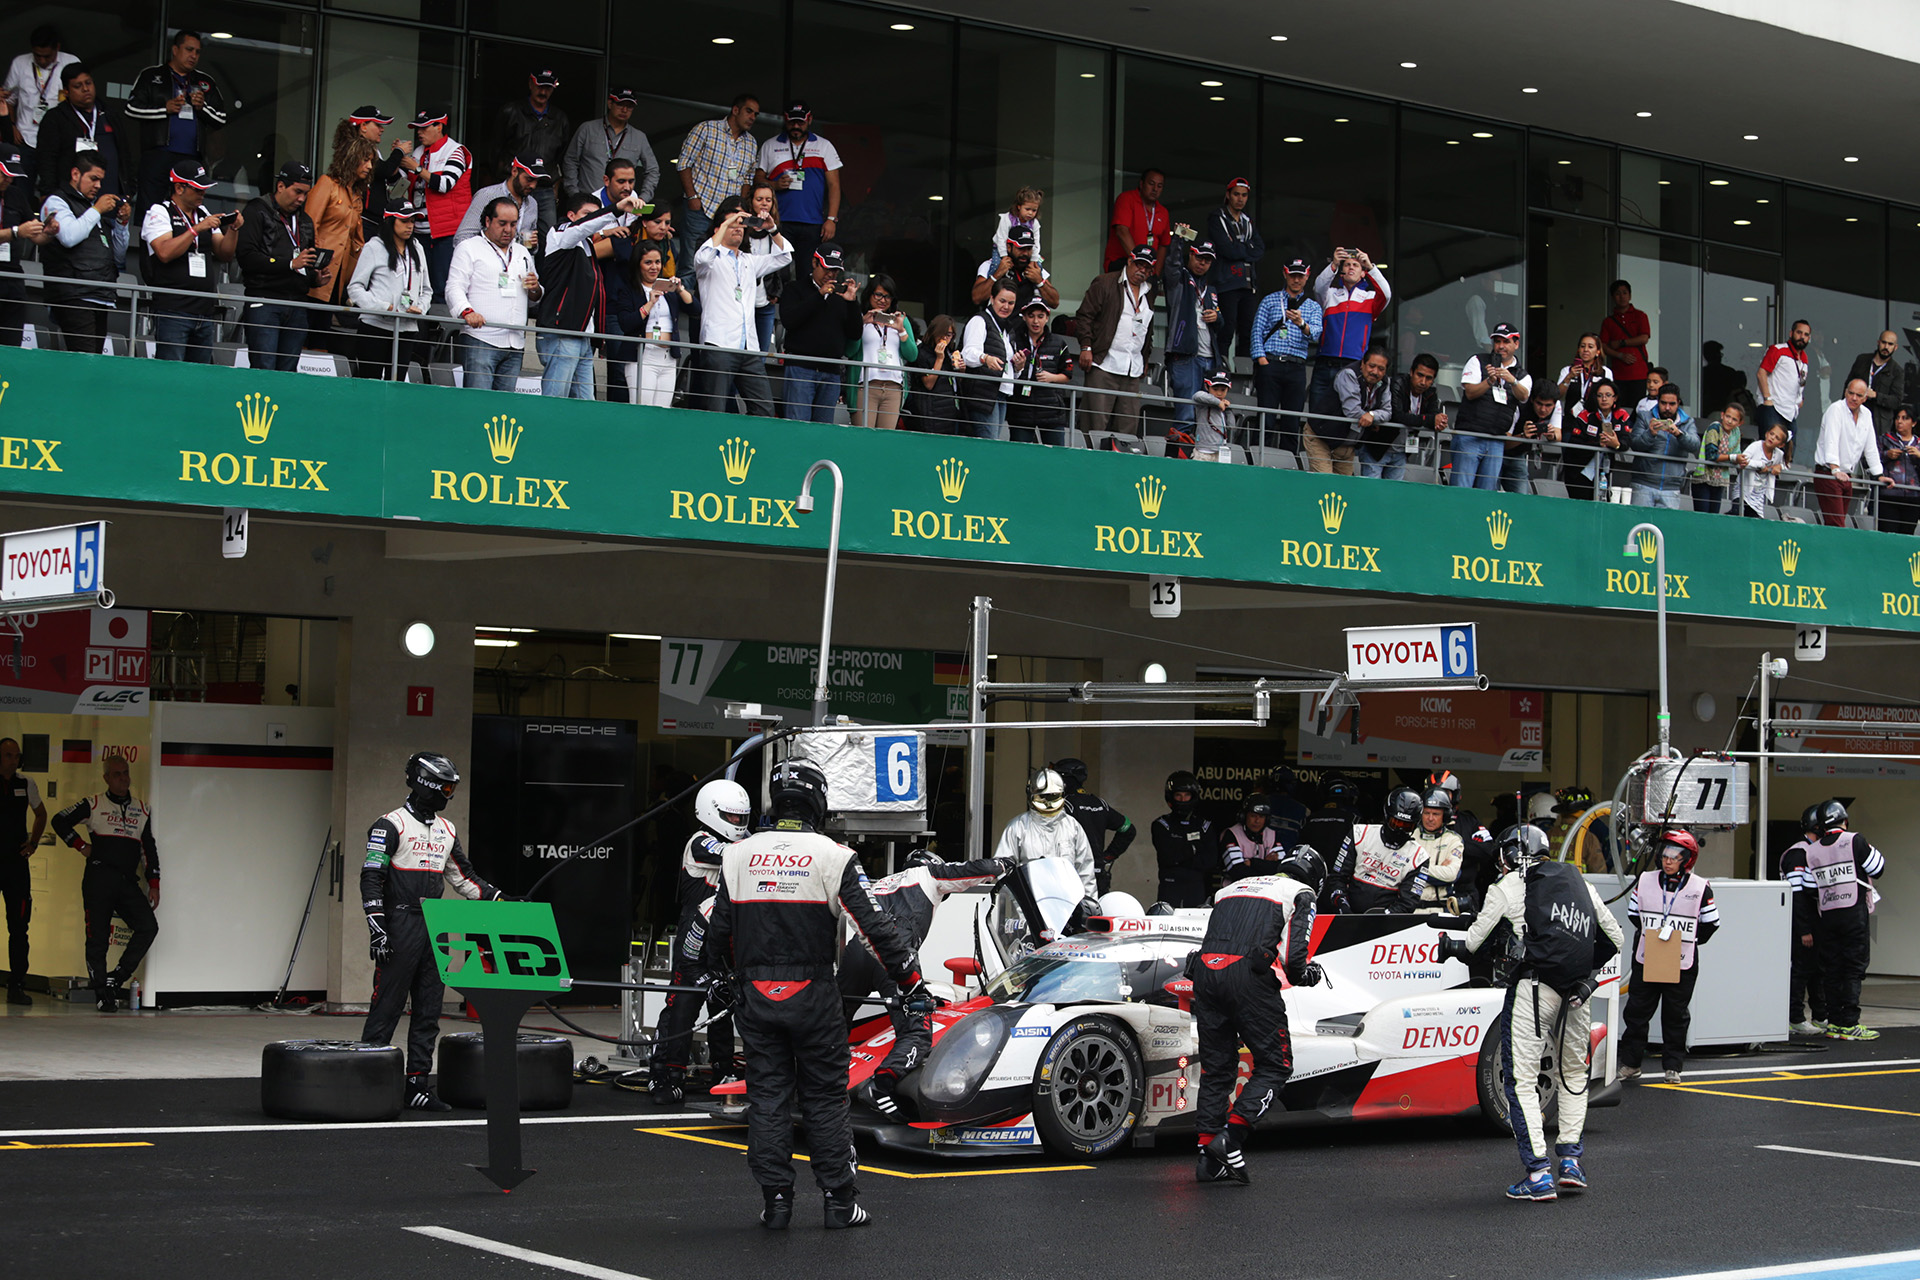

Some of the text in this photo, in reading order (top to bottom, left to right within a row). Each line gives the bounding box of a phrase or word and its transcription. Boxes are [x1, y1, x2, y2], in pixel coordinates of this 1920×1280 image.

[300, 365, 332, 373] RESERVADO
[179, 450, 329, 492] ROLEX
[431, 470, 570, 510] ROLEX
[670, 490, 799, 529] ROLEX
[225, 514, 245, 541] 14
[891, 509, 1010, 545] ROLEX
[1095, 525, 1204, 559] ROLEX
[8, 530, 95, 589] TOYOTA 5
[1281, 540, 1381, 573] ROLEX
[1451, 555, 1544, 588] ROLEX
[1152, 582, 1177, 606] 13
[1606, 568, 1690, 599] ROLEX
[1749, 581, 1828, 611] ROLEX
[1882, 592, 1920, 617] ROL
[1797, 630, 1822, 649] 12
[1352, 629, 1468, 675] TOYOTA 6
[89, 654, 110, 675] P1
[118, 655, 144, 677] HY
[669, 643, 703, 686] 77
[777, 688, 815, 700] PORSCH
[846, 692, 865, 702] RSR
[867, 693, 896, 704] (2016)
[1420, 697, 1452, 713] KCMG
[1395, 716, 1476, 730] PORSCHE 911 RSR
[1837, 705, 1857, 720] ABU
[526, 724, 616, 736] PORSCHE
[1521, 725, 1541, 742] GTE
[1845, 738, 1882, 751] PORSCHE
[1884, 741, 1897, 752] 911
[887, 742, 911, 796] 6
[1196, 766, 1223, 781] ABU
[417, 776, 443, 791] uvex
[1696, 778, 1728, 810] 77
[1397, 811, 1411, 820] uvex
[412, 841, 445, 853] DENSO
[749, 854, 812, 868] DENSO
[1363, 856, 1400, 878] DENSO
[1829, 865, 1853, 877] LANE
[1119, 918, 1153, 931] ZENT
[1370, 943, 1439, 964] DENSO
[1368, 970, 1442, 980] TOYOTA HYBRID
[1014, 1028, 1049, 1037] AISIN
[1050, 1026, 1077, 1060] MICHELIN
[1402, 1025, 1480, 1049] DENSO
[1289, 1072, 1311, 1080] OYOTA
[1337, 1059, 1359, 1070] Racing
[1152, 1084, 1173, 1107] P1
[962, 1130, 1033, 1140] MICHELIN
